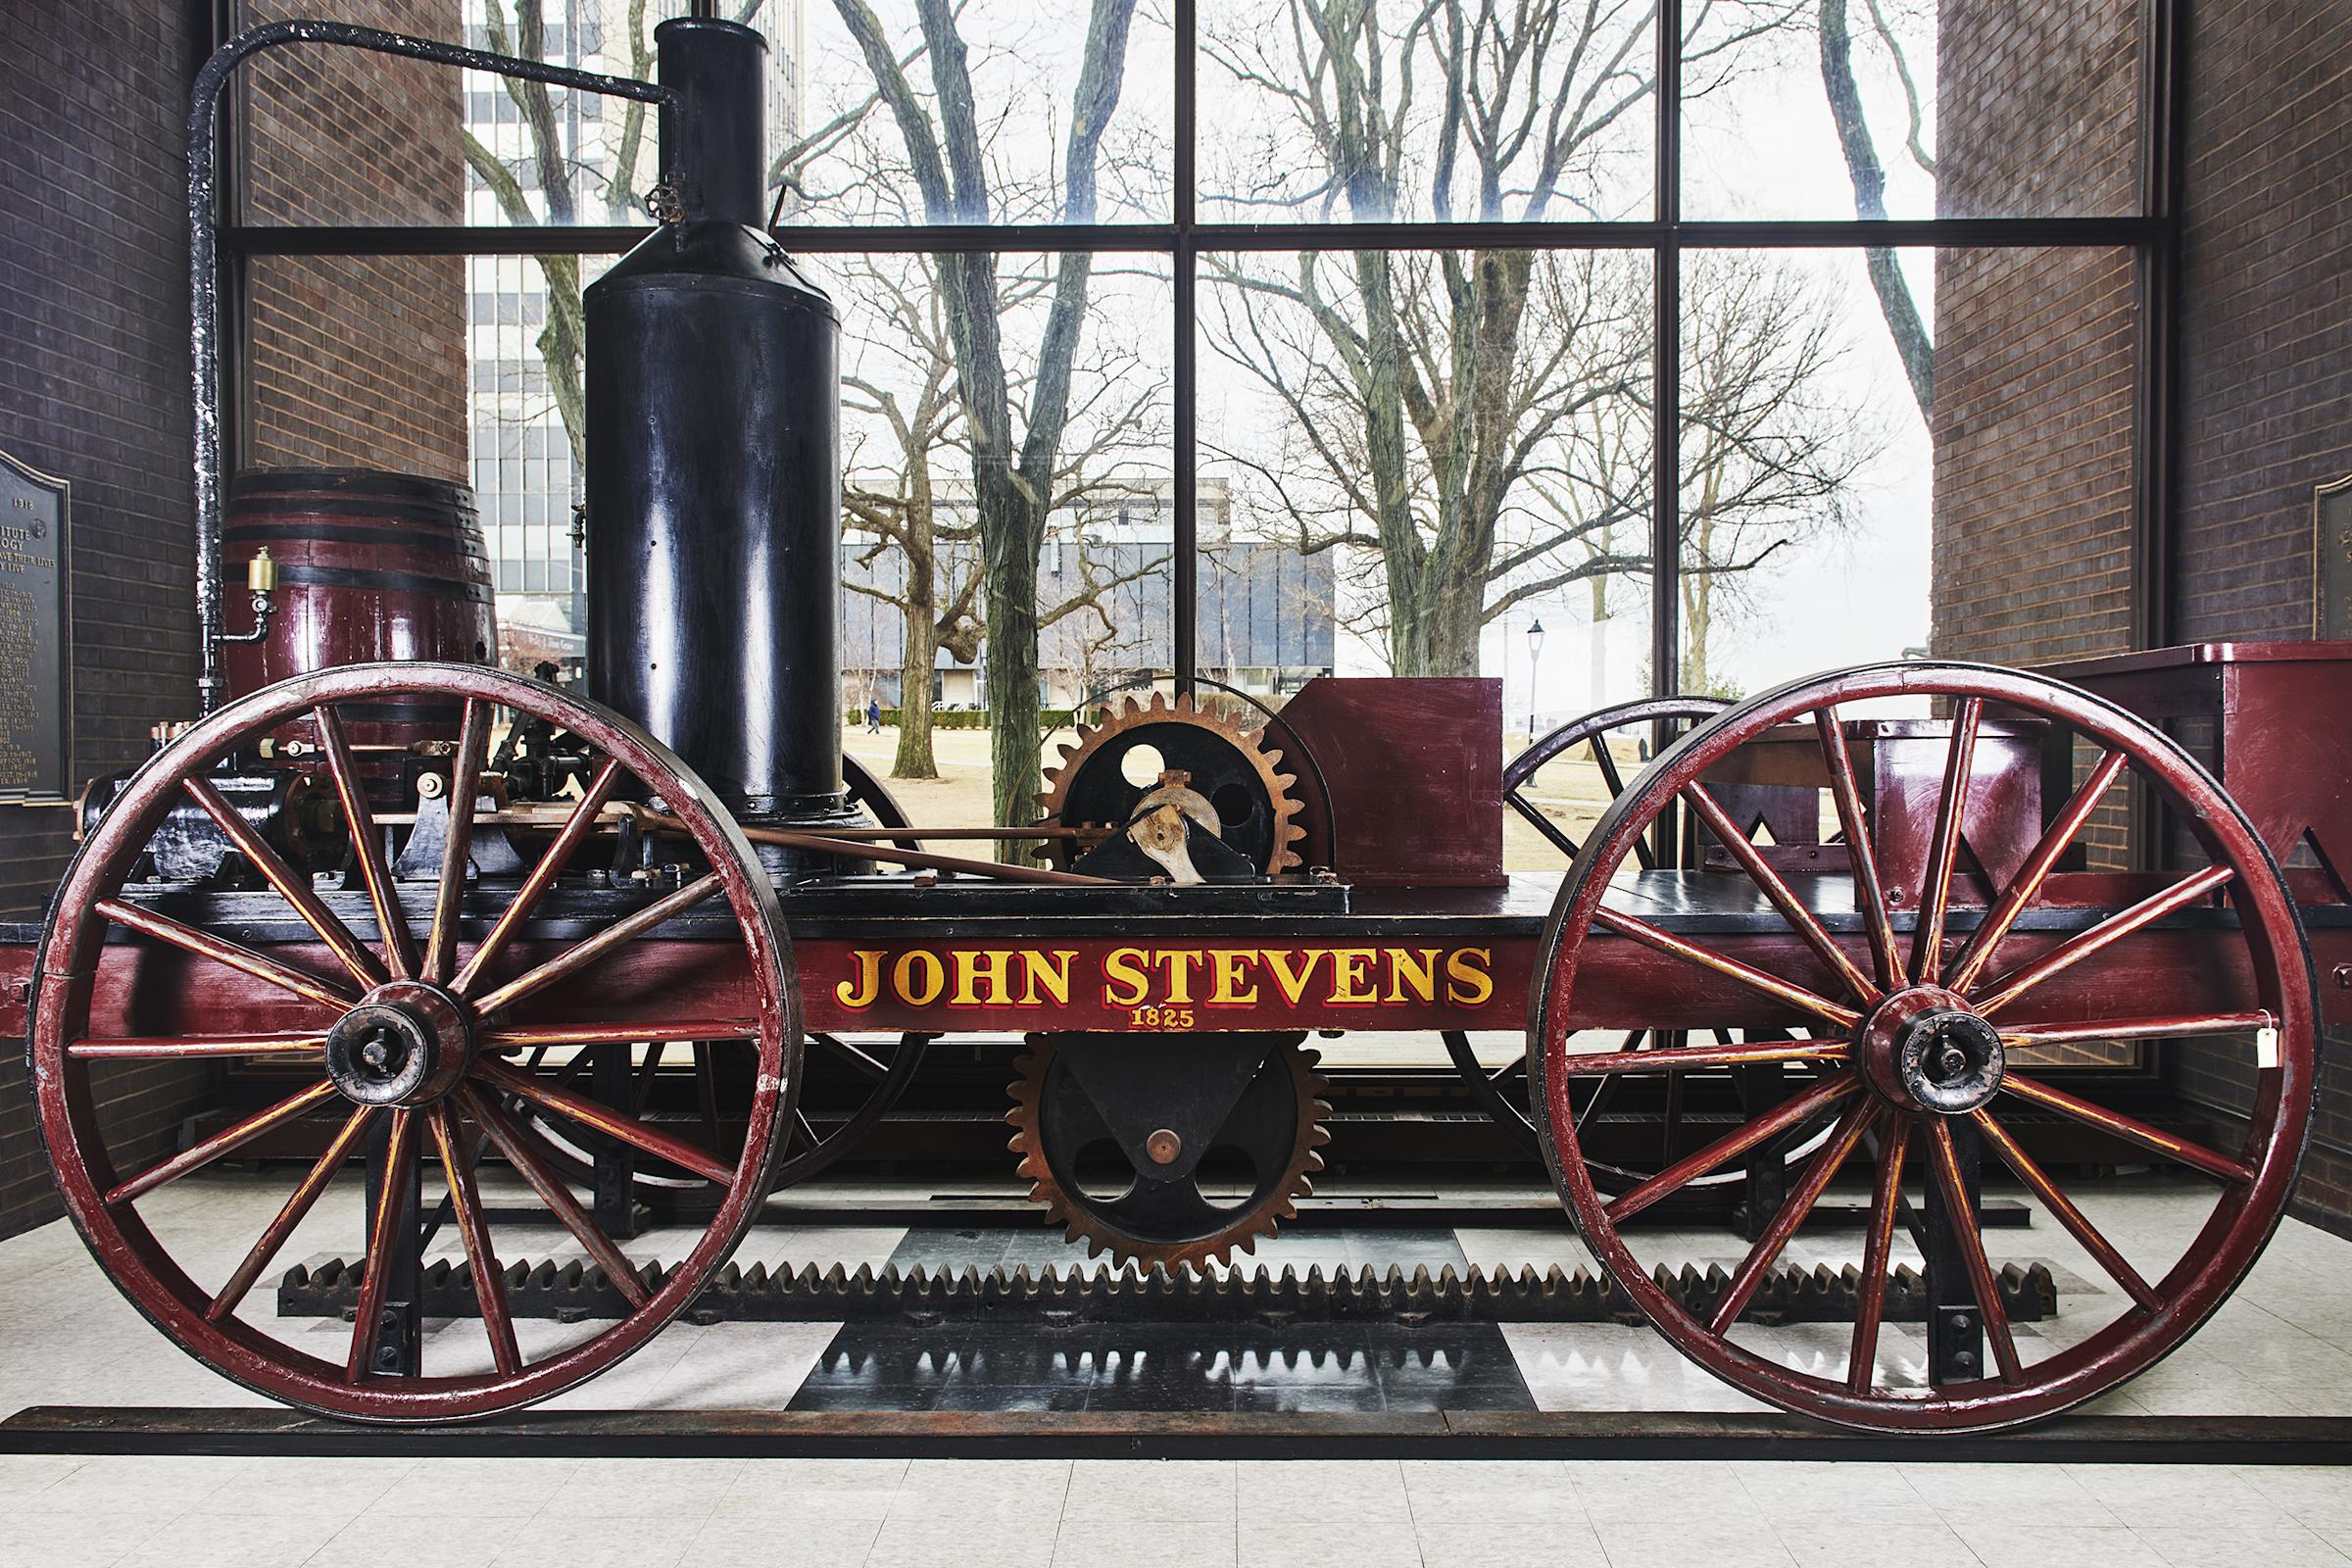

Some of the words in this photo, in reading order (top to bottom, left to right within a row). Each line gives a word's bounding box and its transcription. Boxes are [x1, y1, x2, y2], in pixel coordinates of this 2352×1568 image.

[8, 564, 24, 573] LIVE
[37, 557, 56, 567] LIVES
[835, 949, 1079, 1008] JOHN
[1103, 947, 1494, 1006] STEVENS
[1131, 1007, 1195, 1028] 1825
